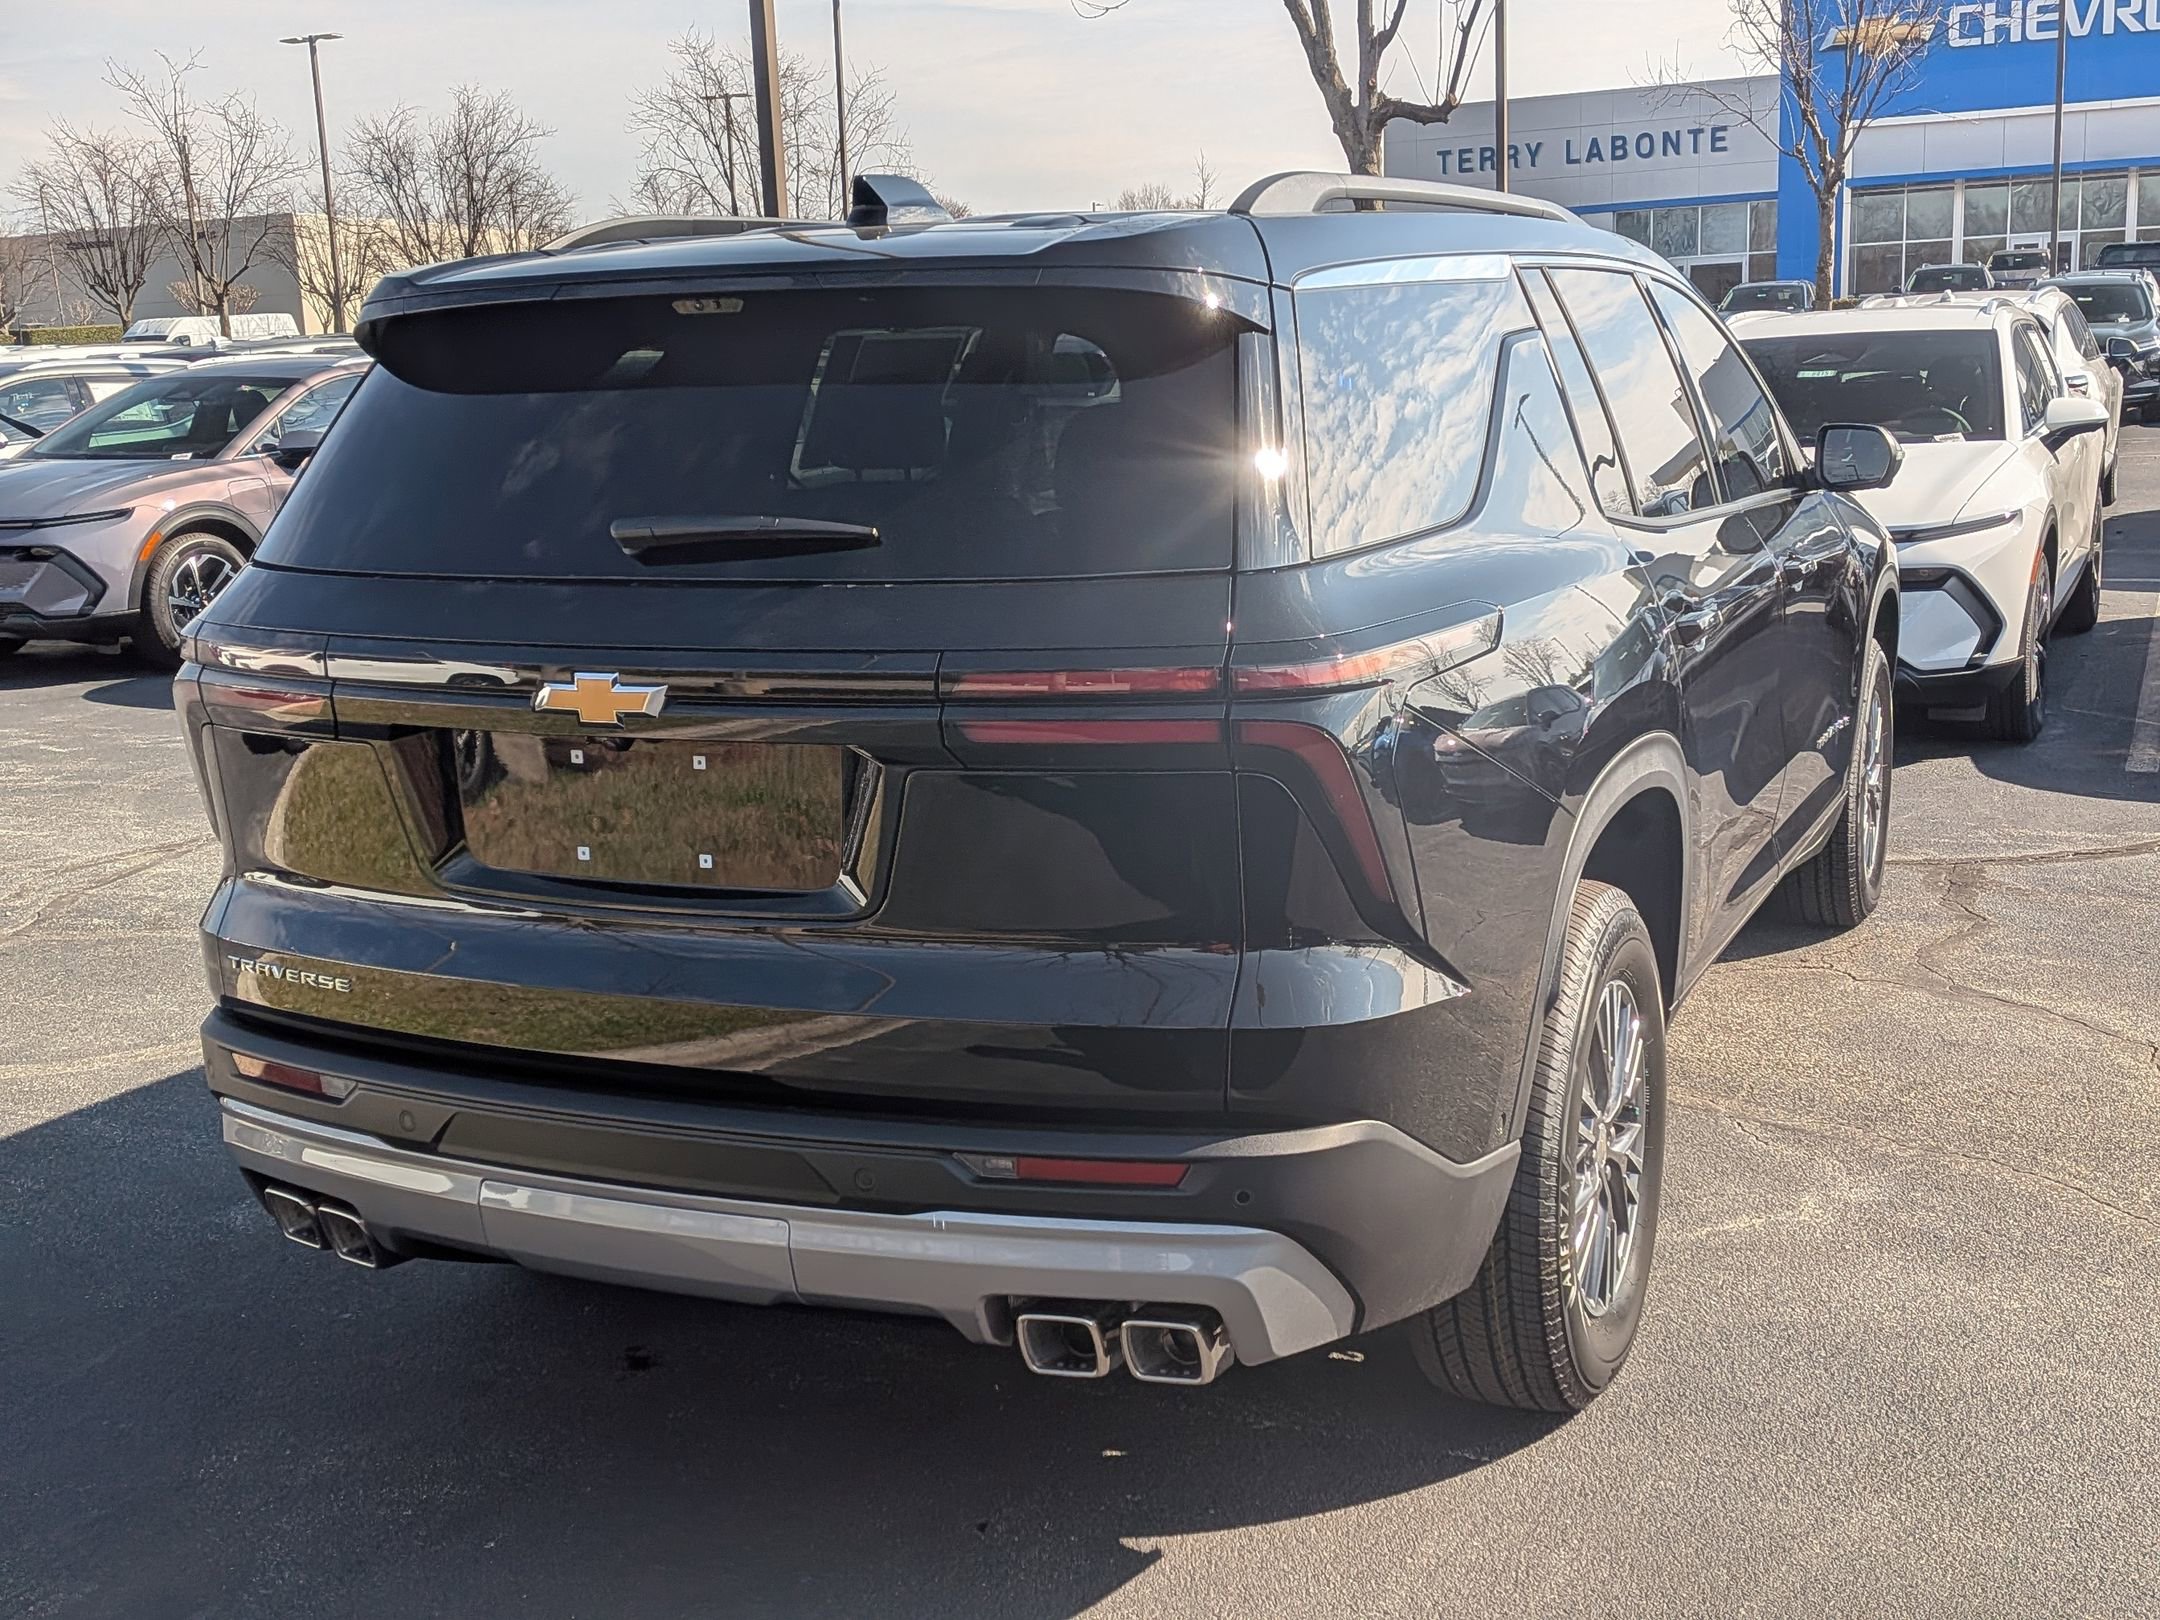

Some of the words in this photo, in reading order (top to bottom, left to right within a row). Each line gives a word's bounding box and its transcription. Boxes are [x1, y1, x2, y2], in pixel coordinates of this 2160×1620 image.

[1436, 141, 1543, 175] TERRY
[1565, 125, 1728, 165] LABONTE
[227, 955, 352, 993] TRAVERSE
[1560, 1181, 1572, 1287] ALENZA
